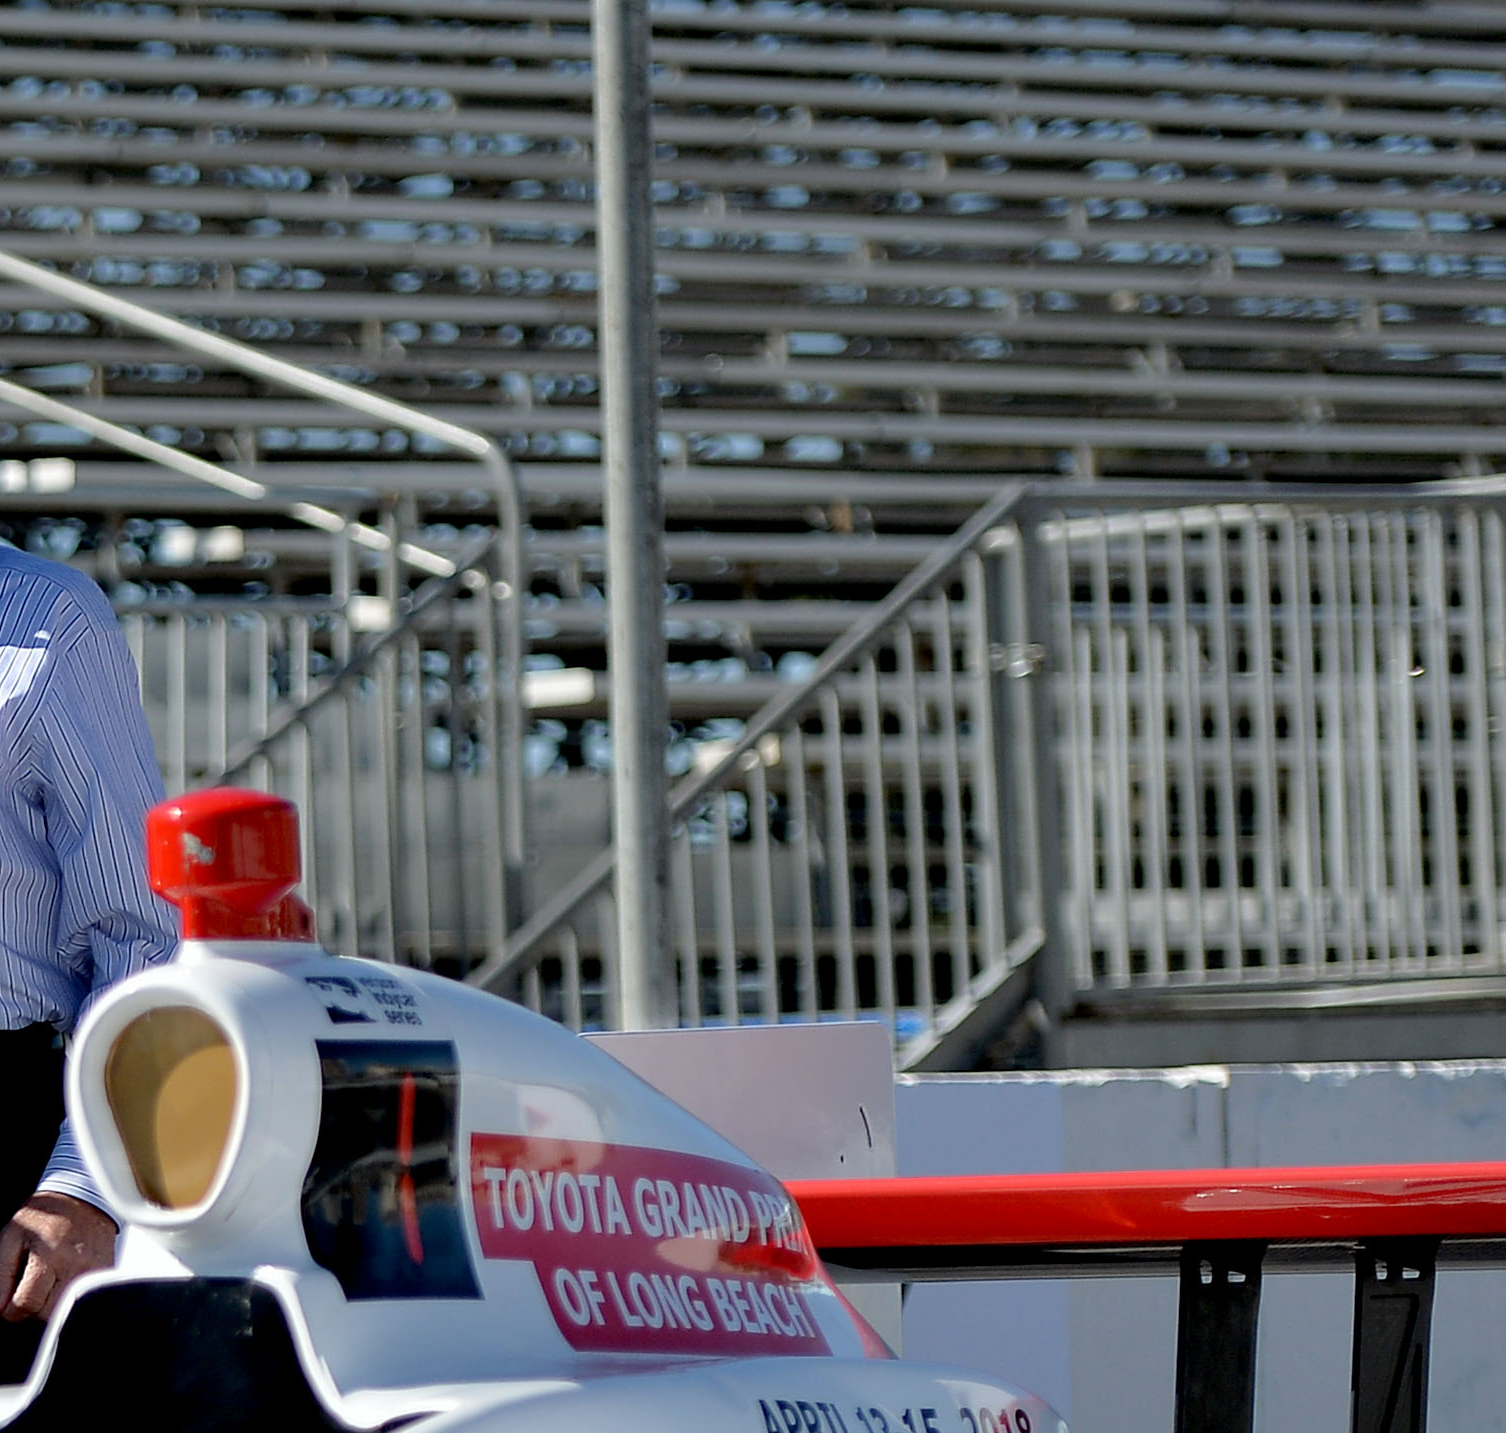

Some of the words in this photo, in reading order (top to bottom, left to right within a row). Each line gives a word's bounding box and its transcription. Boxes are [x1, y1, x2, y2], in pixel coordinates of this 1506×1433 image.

[385, 1010, 423, 1025] series
[484, 1166, 632, 1236] TOYOTA
[635, 1177, 749, 1244] GRAND
[555, 1268, 606, 1326] OF
[606, 1271, 715, 1332] LONG
[706, 1277, 817, 1340] BEACH
